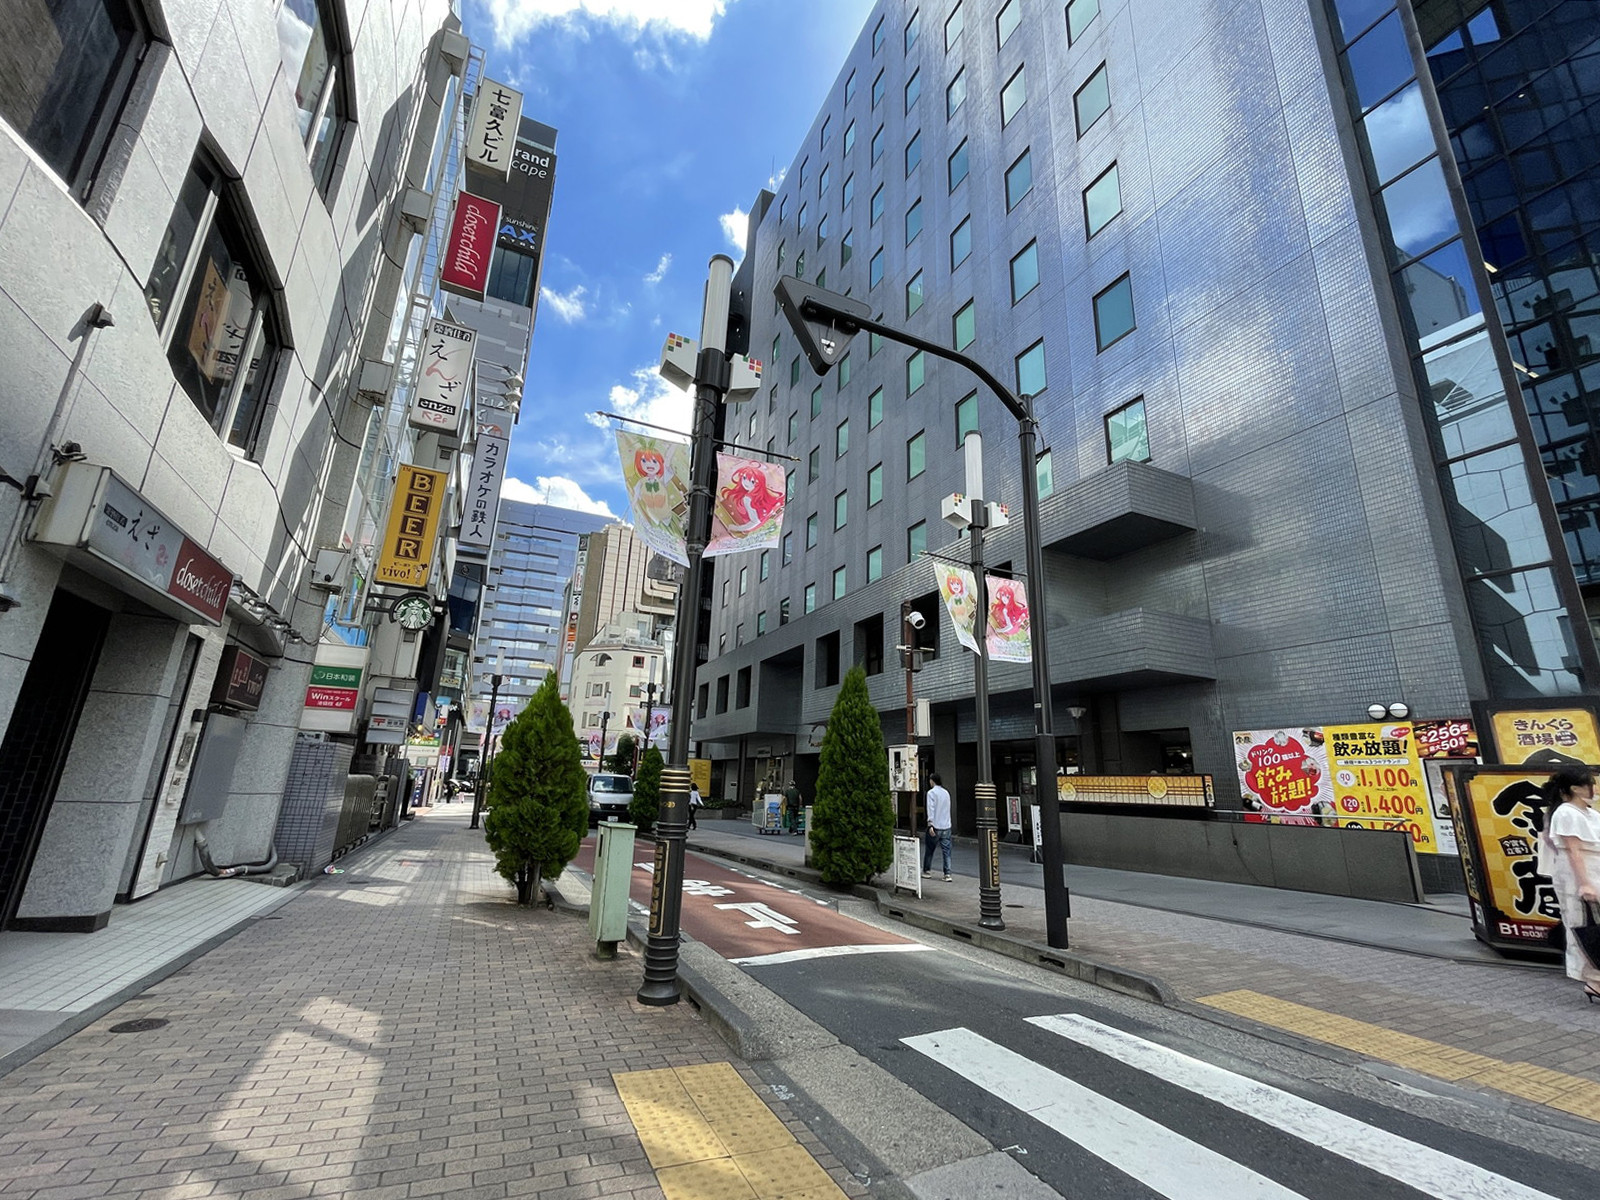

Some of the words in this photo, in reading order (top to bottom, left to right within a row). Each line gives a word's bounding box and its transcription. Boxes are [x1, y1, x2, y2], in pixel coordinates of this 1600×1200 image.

[478, 89, 512, 163] 七富久ビル
[514, 148, 550, 168] rand
[511, 160, 547, 179] cape
[454, 204, 488, 280] closetchild
[499, 224, 537, 245] AX
[426, 339, 466, 399] えんざ
[419, 399, 455, 415] enza
[469, 442, 499, 538] カラオケの鉄人
[399, 473, 431, 559] BEER
[382, 566, 411, 579] vivo!
[176, 558, 228, 609] closetchild
[1514, 718, 1574, 731] きんくら
[1517, 732, 1555, 746] 酒場
[1251, 748, 1274, 758] ドリンク
[1343, 797, 1358, 807] 120
[1498, 922, 1520, 936] B1
